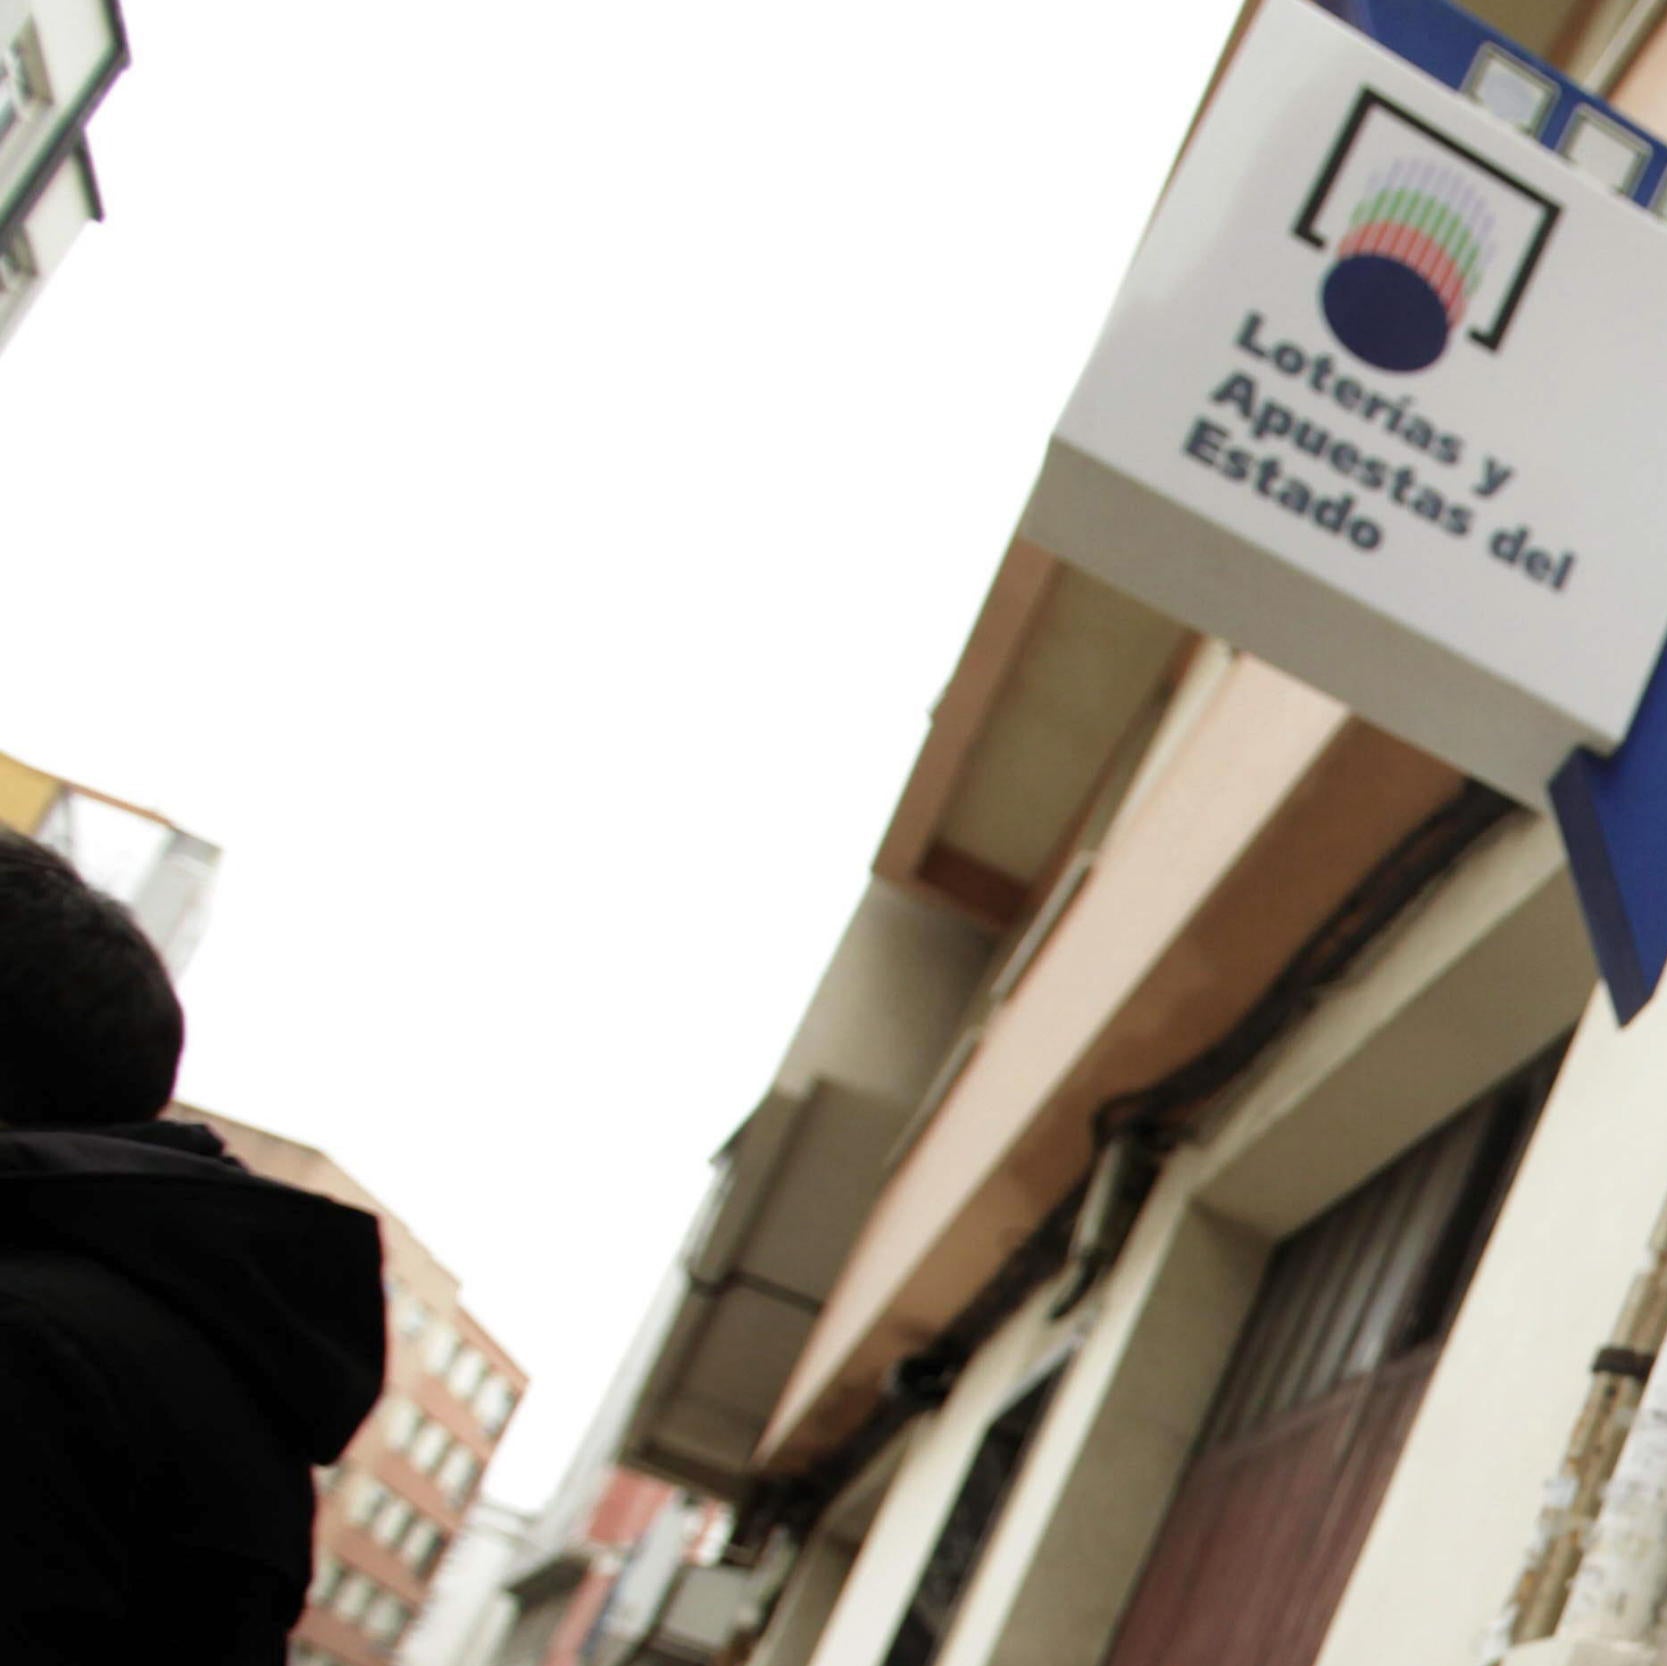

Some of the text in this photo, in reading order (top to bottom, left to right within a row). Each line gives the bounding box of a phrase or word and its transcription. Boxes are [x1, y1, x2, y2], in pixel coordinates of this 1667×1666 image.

[1181, 415, 1385, 554] Estado
[1209, 369, 1579, 594] Apuestas del
[1234, 311, 1516, 500] Loterías y
